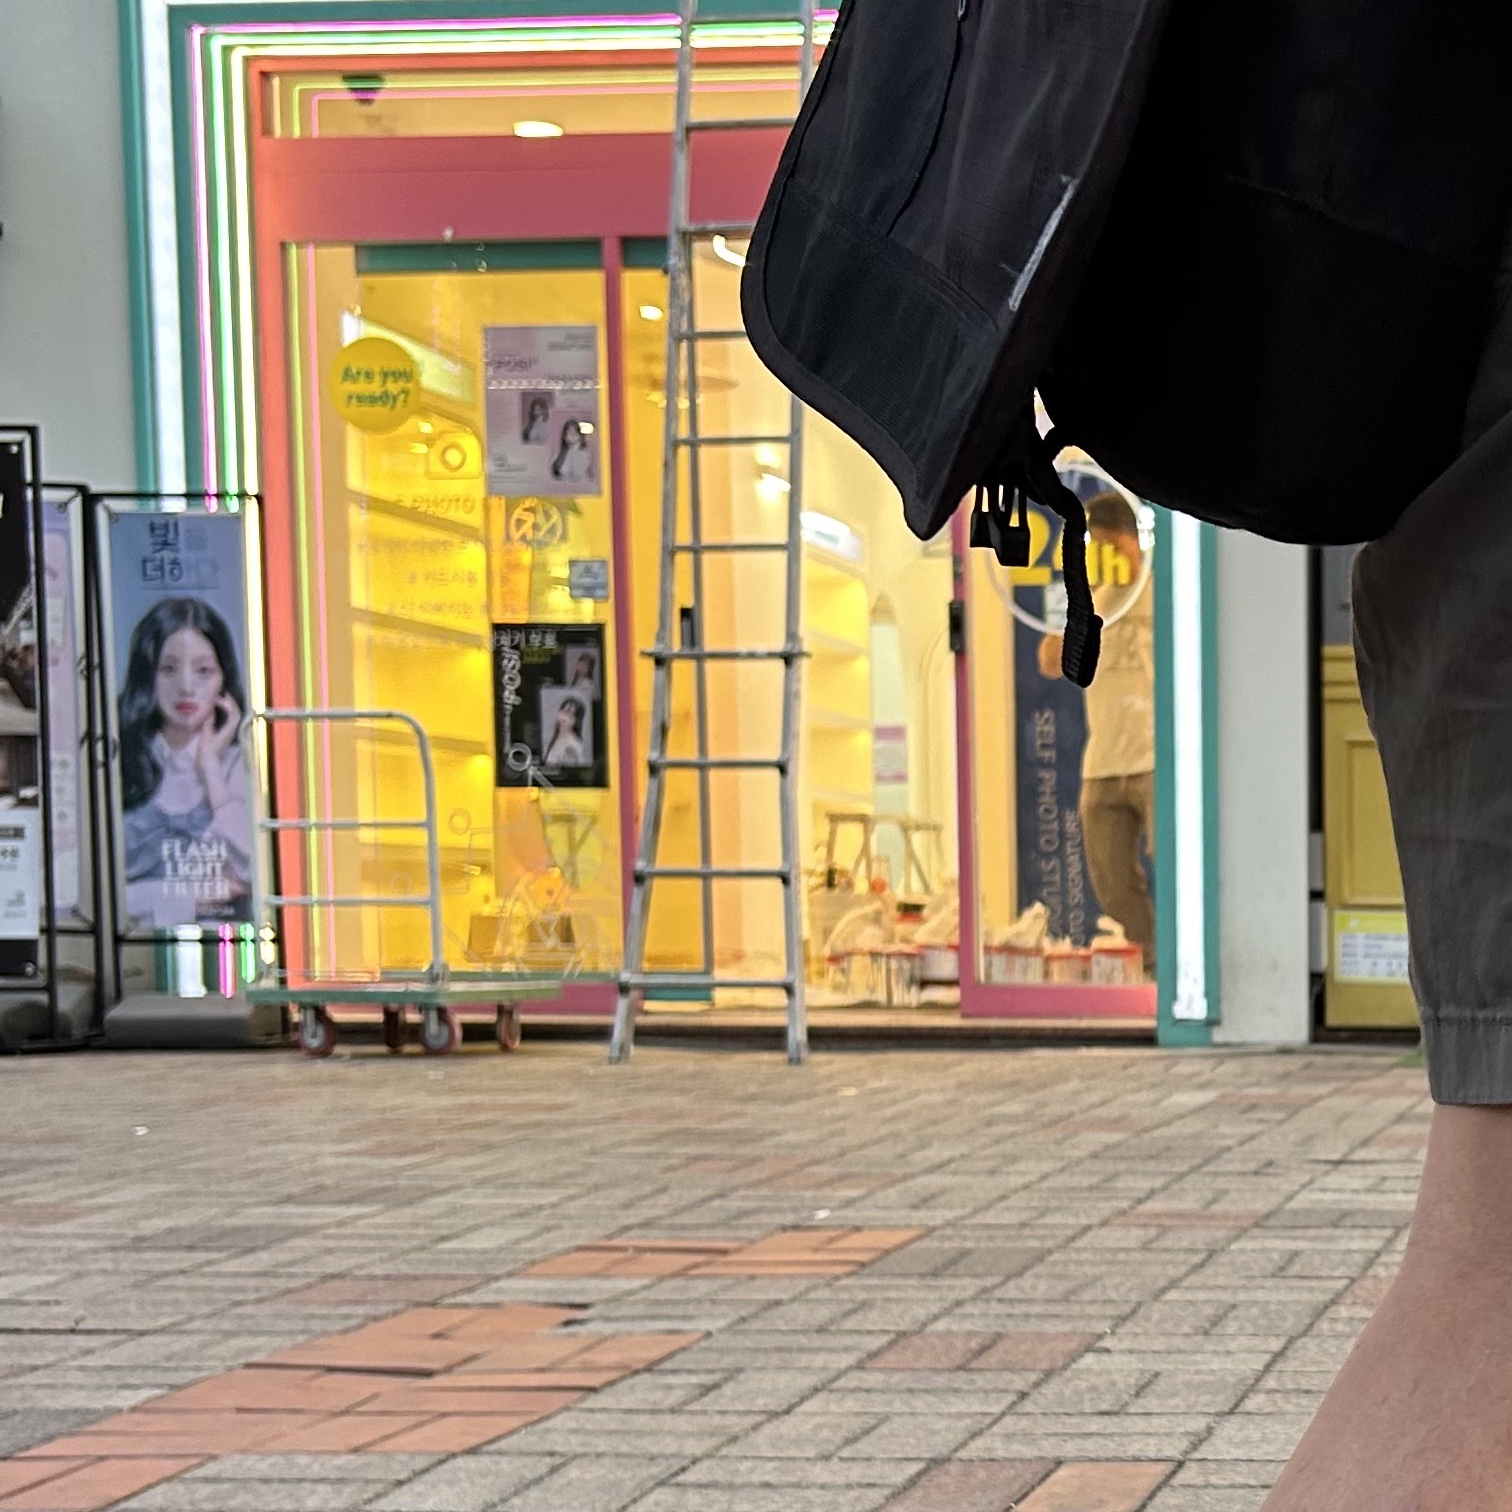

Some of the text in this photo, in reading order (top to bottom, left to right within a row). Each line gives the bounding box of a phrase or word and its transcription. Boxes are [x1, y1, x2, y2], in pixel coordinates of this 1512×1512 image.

[341, 365, 414, 388] Are you
[346, 387, 410, 411] ready?
[1035, 708, 1057, 764] SELF
[1038, 768, 1060, 853] PHOTO
[164, 861, 224, 879] LIGHT
